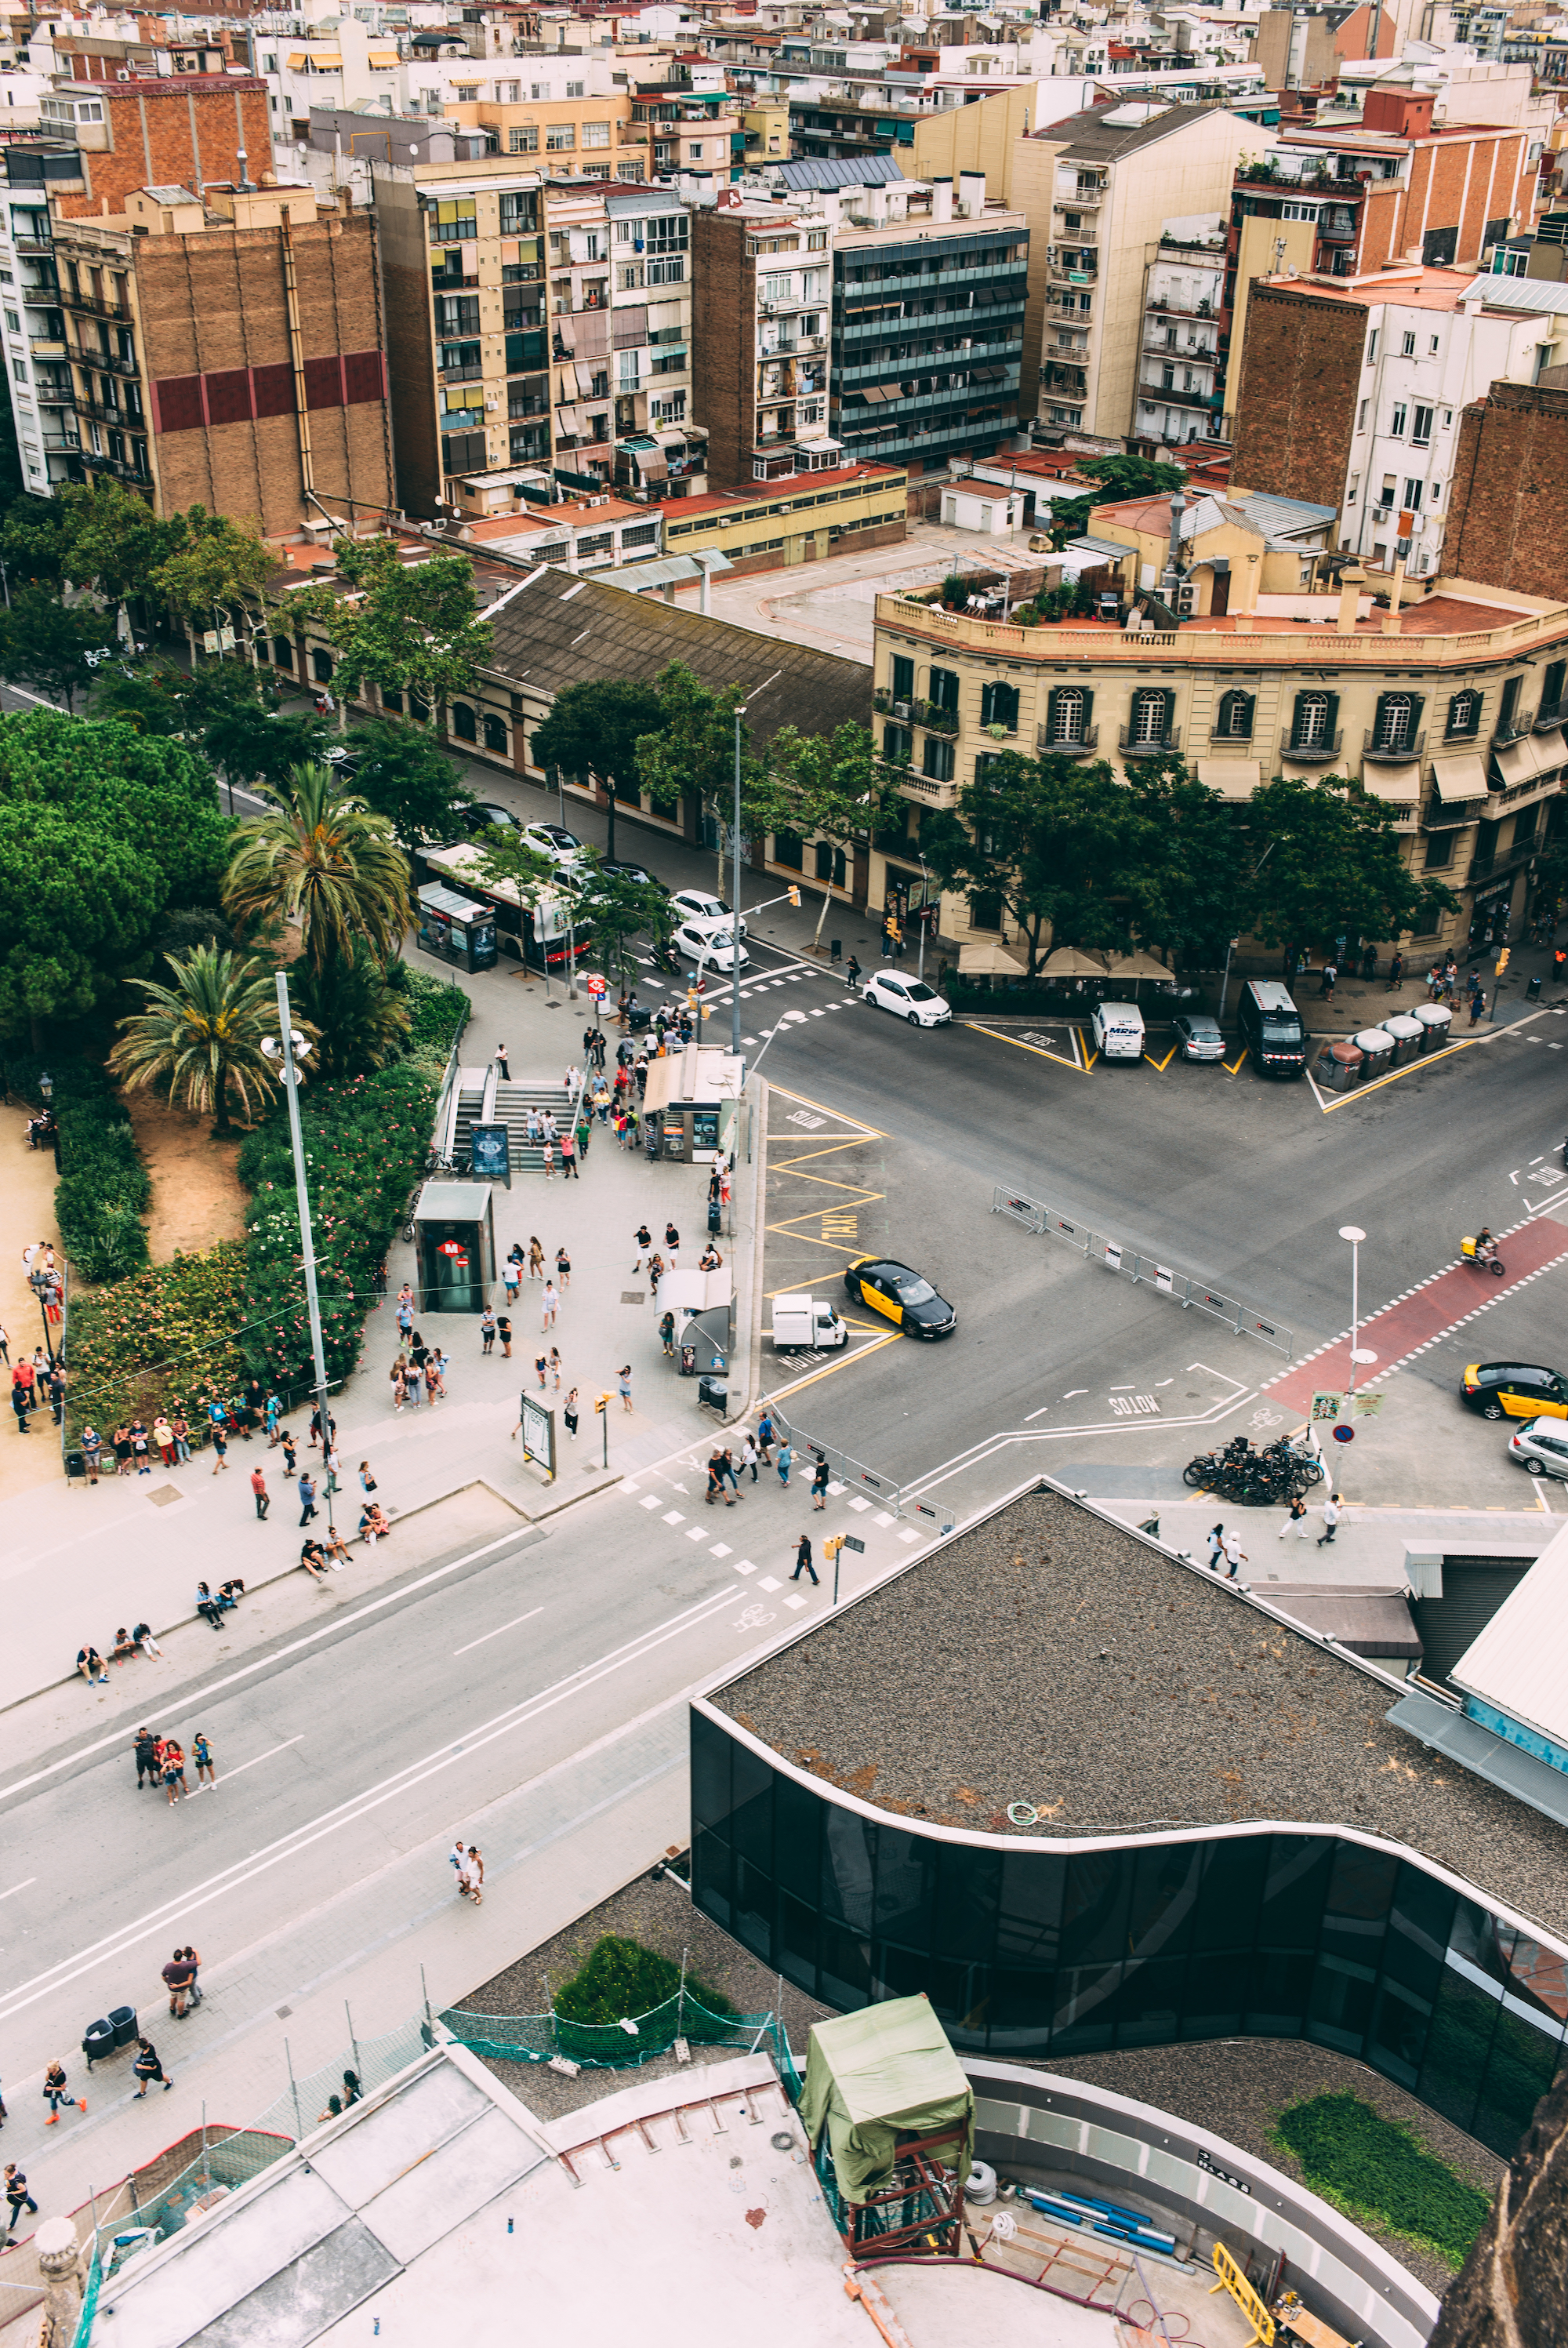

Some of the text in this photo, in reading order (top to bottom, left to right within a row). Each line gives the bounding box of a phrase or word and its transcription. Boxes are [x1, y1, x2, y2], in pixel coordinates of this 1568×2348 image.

[1018, 1030, 1057, 1047] MOTOS
[785, 1110, 828, 1130] MOTOS
[1526, 1165, 1568, 1187] MOTOS
[821, 1215, 858, 1240] TAXI
[445, 1243, 459, 1254] M
[1108, 1394, 1161, 1416] MOTOS
